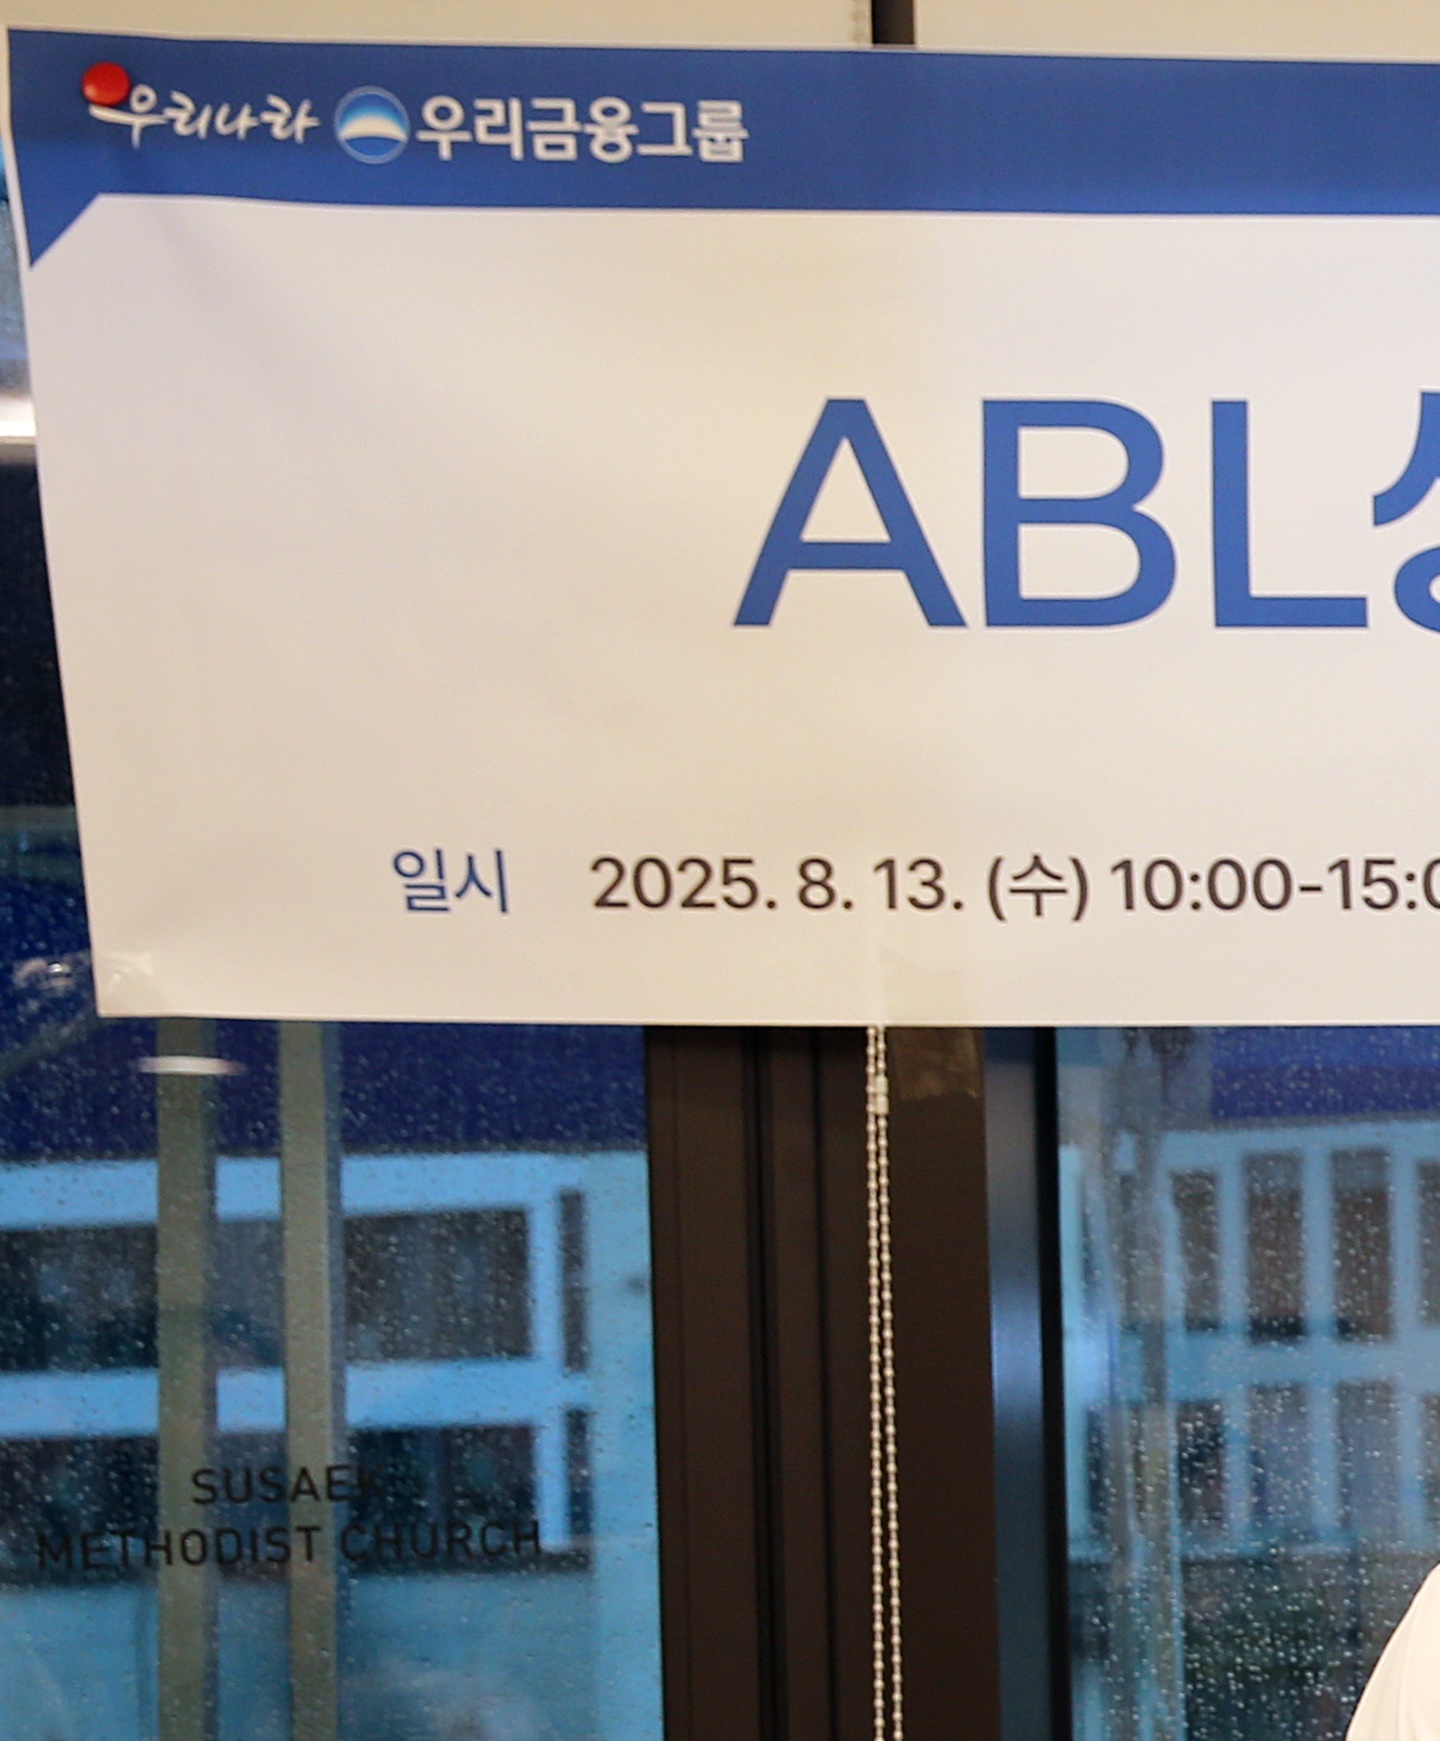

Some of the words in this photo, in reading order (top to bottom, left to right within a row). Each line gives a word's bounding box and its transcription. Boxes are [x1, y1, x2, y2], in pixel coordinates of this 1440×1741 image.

[88, 83, 320, 150] 우리나라
[417, 96, 748, 162] 우리금융그룹
[393, 849, 507, 913] 일시
[592, 857, 776, 909] 2025.
[799, 858, 852, 909] 8.
[874, 858, 963, 910] 13.
[989, 855, 1088, 921] (수)
[192, 1464, 387, 1506] SUSAEK
[37, 1525, 322, 1570] METHODIST
[340, 1520, 540, 1562] CHURCH
